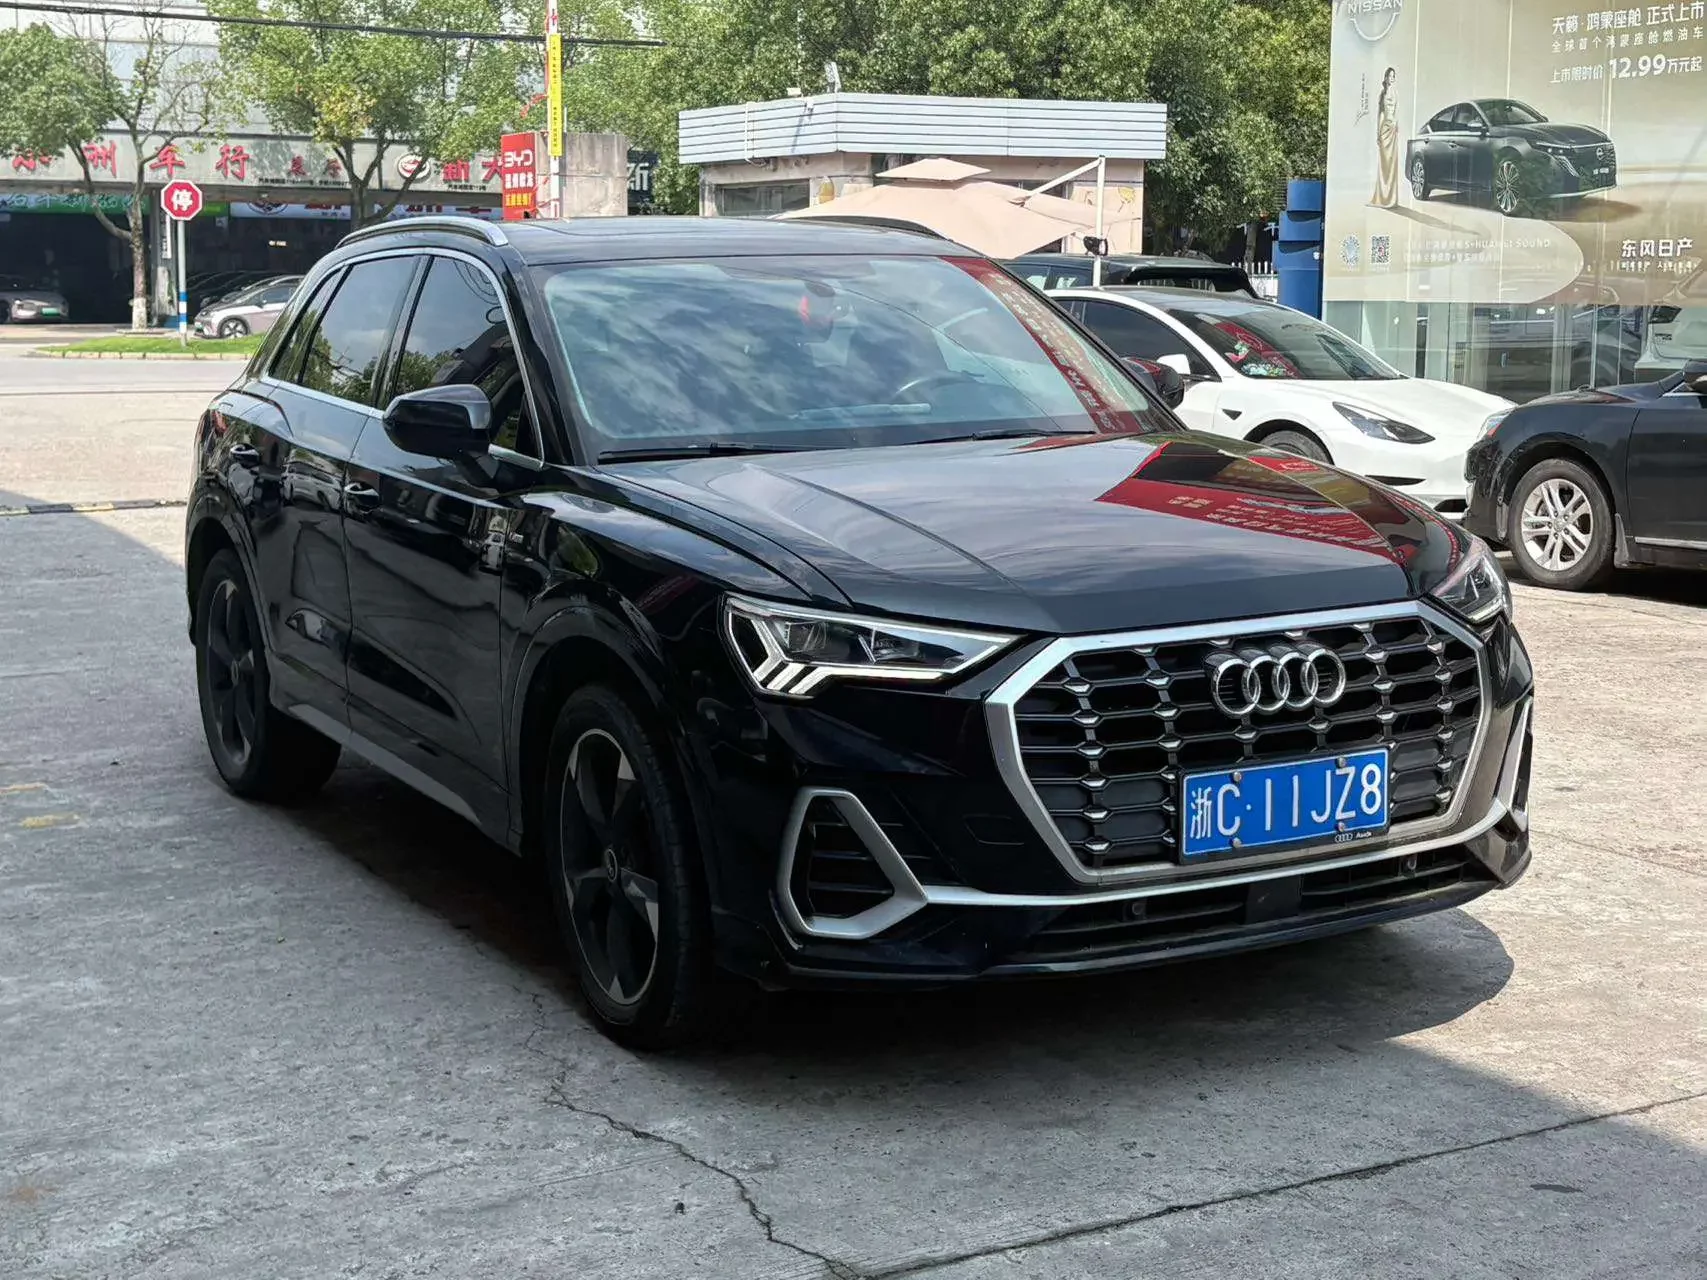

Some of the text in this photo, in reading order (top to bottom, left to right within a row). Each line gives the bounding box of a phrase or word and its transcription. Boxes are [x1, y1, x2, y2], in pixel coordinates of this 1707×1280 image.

[1347, 0, 1402, 15] NISSAN
[1646, 1, 1705, 25] 正式上市
[504, 149, 533, 168] BYD
[171, 188, 193, 211] 停
[1622, 237, 1693, 257] 东风日产
